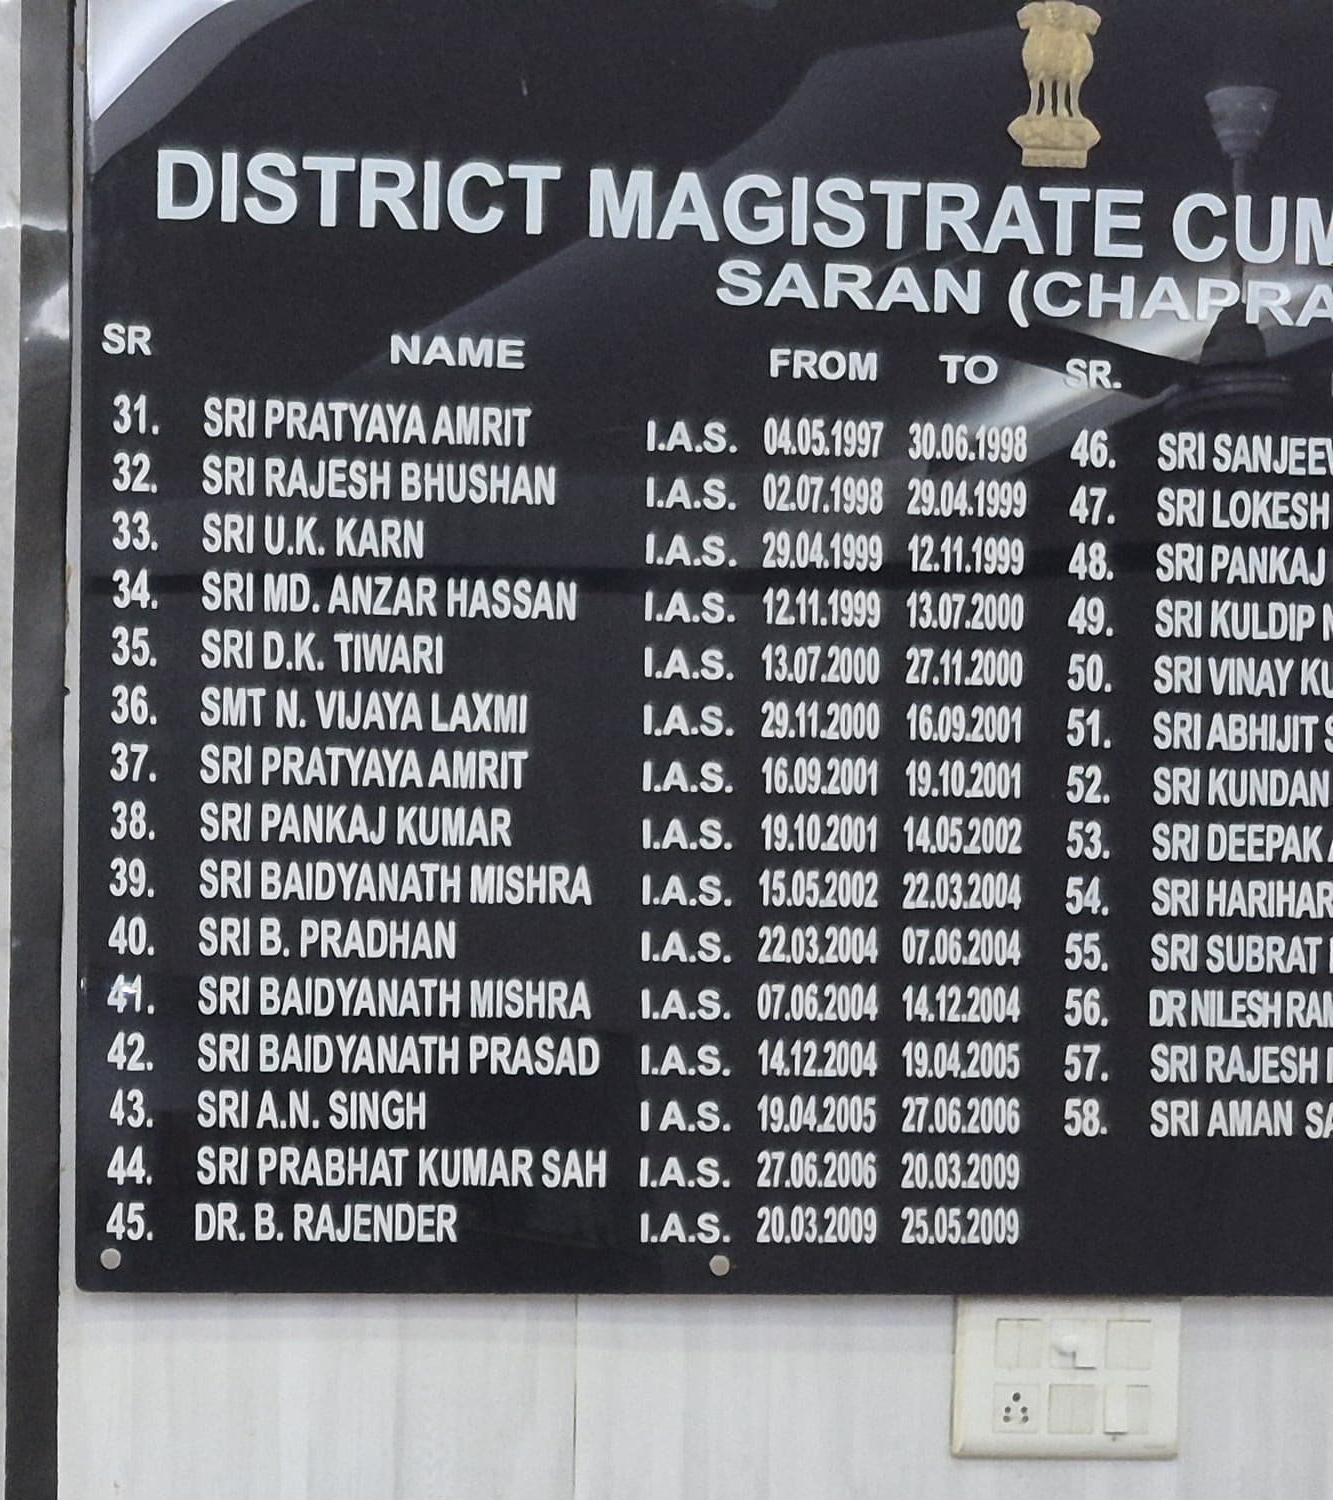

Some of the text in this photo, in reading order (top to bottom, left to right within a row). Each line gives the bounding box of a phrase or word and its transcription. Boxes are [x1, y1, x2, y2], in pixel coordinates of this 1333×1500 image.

[157, 149, 562, 236] DISTRICT
[589, 168, 1144, 259] MAGISTRATE
[717, 259, 981, 315] SARAN
[101, 322, 152, 357] SR
[390, 334, 526, 370] NAME
[770, 348, 878, 381] FROM
[938, 354, 1000, 386] TO
[1064, 359, 1122, 391] SR.
[113, 394, 1027, 463] 31. SRI PRATYAYA AMRIT I.A.S. 04.05.1997 30.06.1998
[1071, 428, 1205, 471] 46. SRI
[113, 452, 1026, 518] 32. SRI RAJESH BHUSHAN I.A.S. 02.07.1998 29.04.1999
[1070, 485, 1329, 529] 47. SRI LOKESH
[113, 510, 1024, 575] 33. SRI U.K. KARN I.A.S. 29.04.1999 12.11.1999
[1069, 542, 1325, 586] 48. SRI PANKAJ
[113, 568, 1024, 631] 34. SRI MD. ANZAR HASSAN I.A.S. 12.11.1999 13.07.2000
[1068, 596, 1113, 636] 49.
[1155, 599, 1202, 638] SRI
[1211, 600, 1315, 641] KULDIP
[112, 626, 1023, 687] 35. SRI D.K. TIWARI I.A.S. 13.07.2000 27.11.2000
[1068, 654, 1294, 697] 50. SRI VINAY
[111, 685, 1021, 743] 36. SMT N. VIJAYA LAXMI I.A.S. 29.11.2000 16.09.2001
[1067, 708, 1110, 748] 51.
[1154, 711, 1201, 750] SRI
[1206, 713, 1319, 753] ABHIJIT
[110, 742, 1020, 798] 37. SRI PRATYAYA AMRIT I.A.S. 16.09.2001 19.10.2001
[1067, 765, 1329, 807] 52. SRI KUNDAN
[111, 801, 1022, 854] 38. SRI PANKAJ KUMAR I.A.S. 19.10.2001 14.05.2002
[1067, 821, 1323, 862] 53. SRI DEEPAK
[110, 857, 1021, 910] 39. SRI BAIDYANATH MISHRA 15.05.2002 22.03.2004
[1066, 876, 1198, 916] 54. SRI
[109, 916, 1021, 966] 40. SRI B. PRADHAN I.A.S. 22.03.2004 07.06.2004
[1065, 933, 1322, 974] 55. SRI SUBRAT
[198, 976, 1020, 1023] SRI BAIDYANATH MISHRA 07.06.2004 14.12.2004
[1065, 988, 1281, 1028] 56. DR NILESH
[108, 1032, 1020, 1079] 42. SRI BAIDYANATH PRASAD 14.12.2004 19.04.2005
[1065, 1043, 1318, 1083] 57. SRI RAJESH
[110, 1089, 1020, 1134] 43. SRI A.N. SINGH 19.04.2005 27.06.2006
[1064, 1098, 1292, 1137] 58. SRI AMAN
[107, 1146, 1019, 1189] 44. SRI PRABHAT KUMAR SAH 27.06.2006 20.03.2009
[107, 1202, 1019, 1245] 45. DR. B. RAJENDER 20.03.2009 25.05.2009
